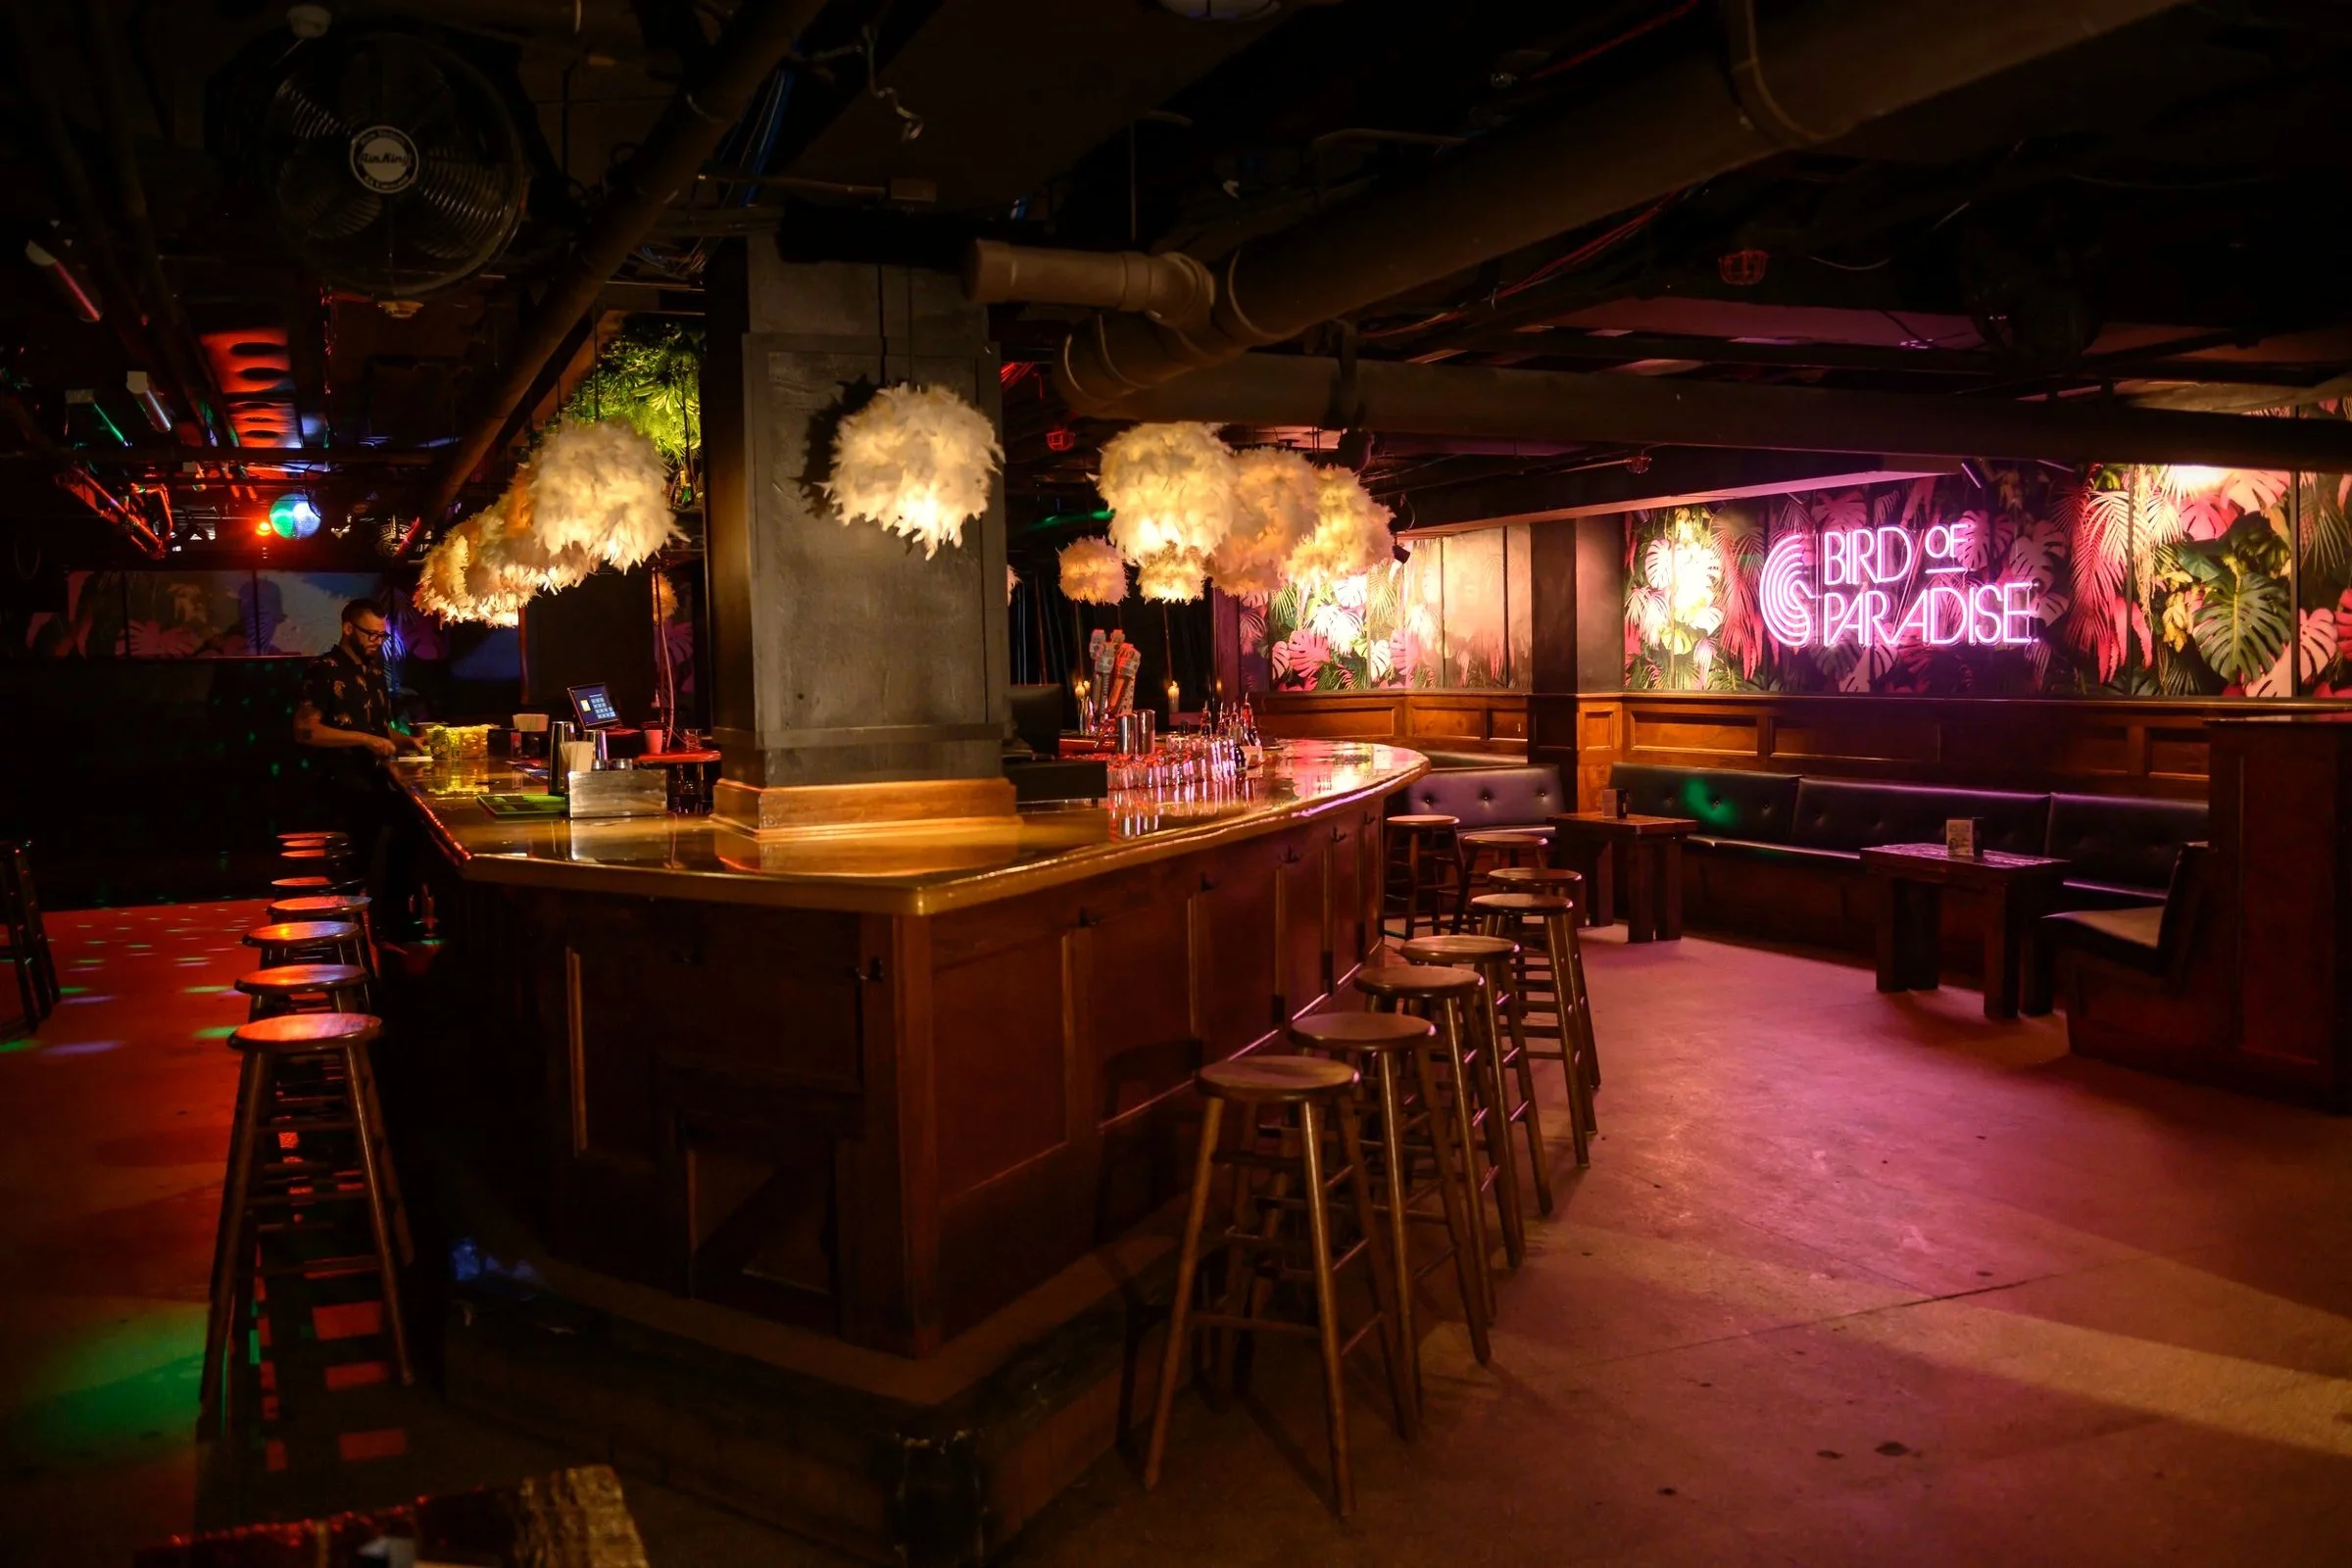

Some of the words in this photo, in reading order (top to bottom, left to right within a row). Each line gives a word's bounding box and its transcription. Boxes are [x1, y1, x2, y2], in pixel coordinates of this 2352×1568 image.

[1823, 525, 1913, 586] BIRD
[1925, 522, 1977, 560] OF
[1823, 581, 2037, 648] PARADISE
